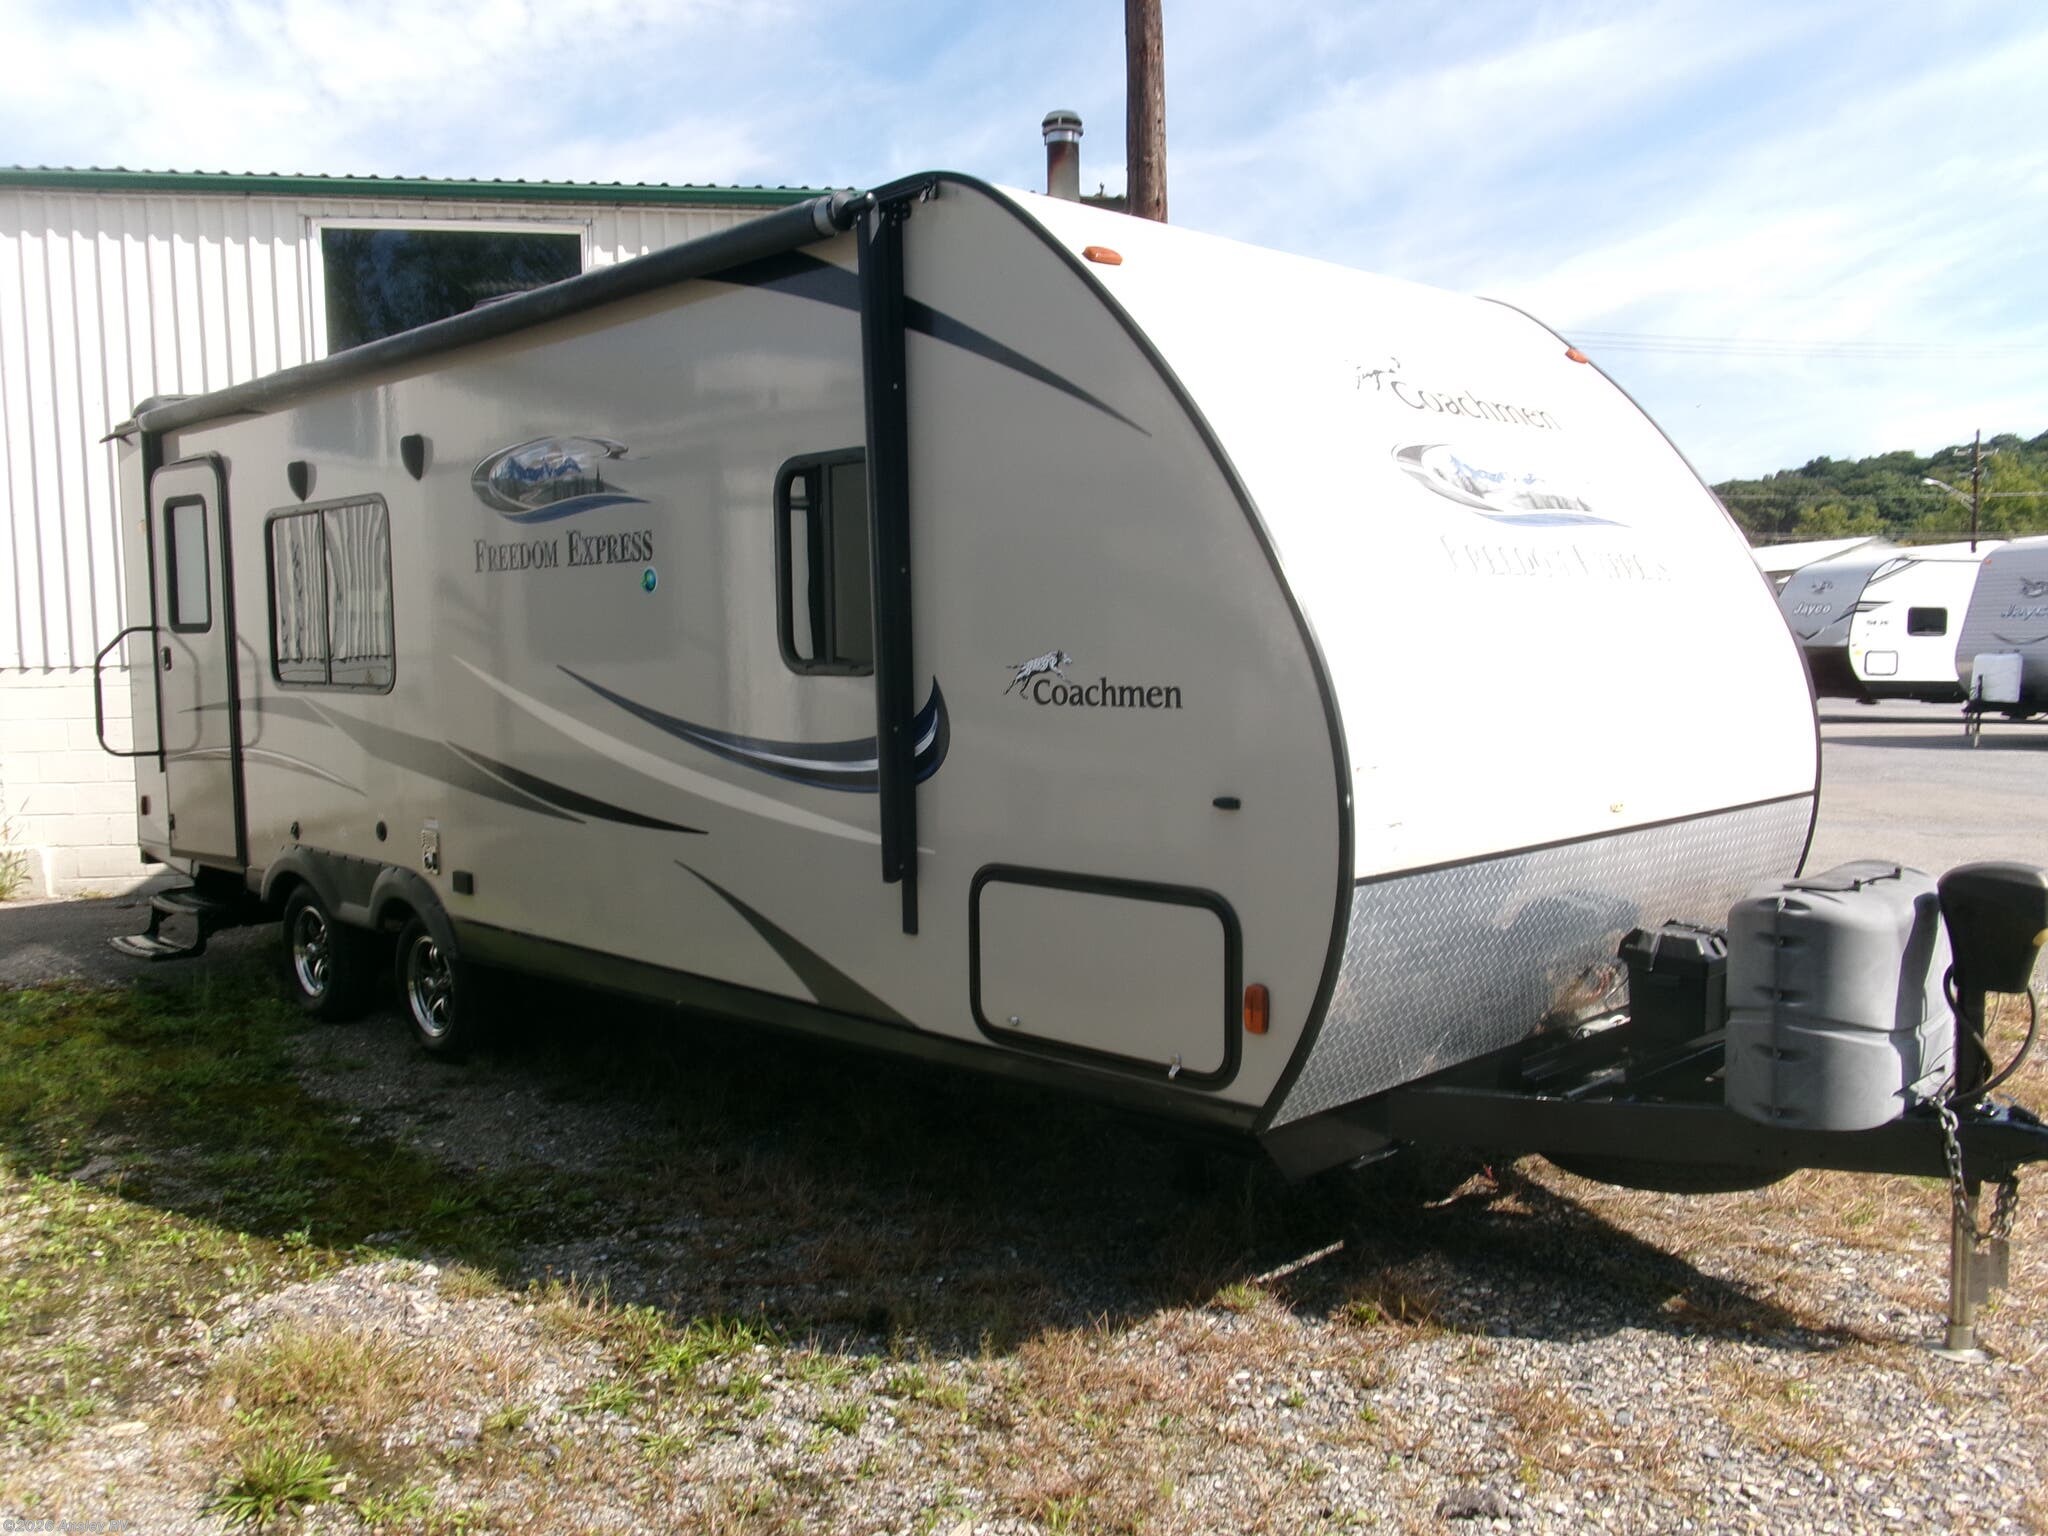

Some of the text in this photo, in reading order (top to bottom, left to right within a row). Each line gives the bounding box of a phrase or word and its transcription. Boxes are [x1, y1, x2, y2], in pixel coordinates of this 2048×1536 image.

[1391, 380, 1562, 431] Coachmen
[473, 529, 653, 574] FREEDOM EXPRESS
[1792, 601, 1832, 617] Jayco
[2000, 603, 2048, 621] Jayc
[1033, 677, 1183, 709] Coachmen
